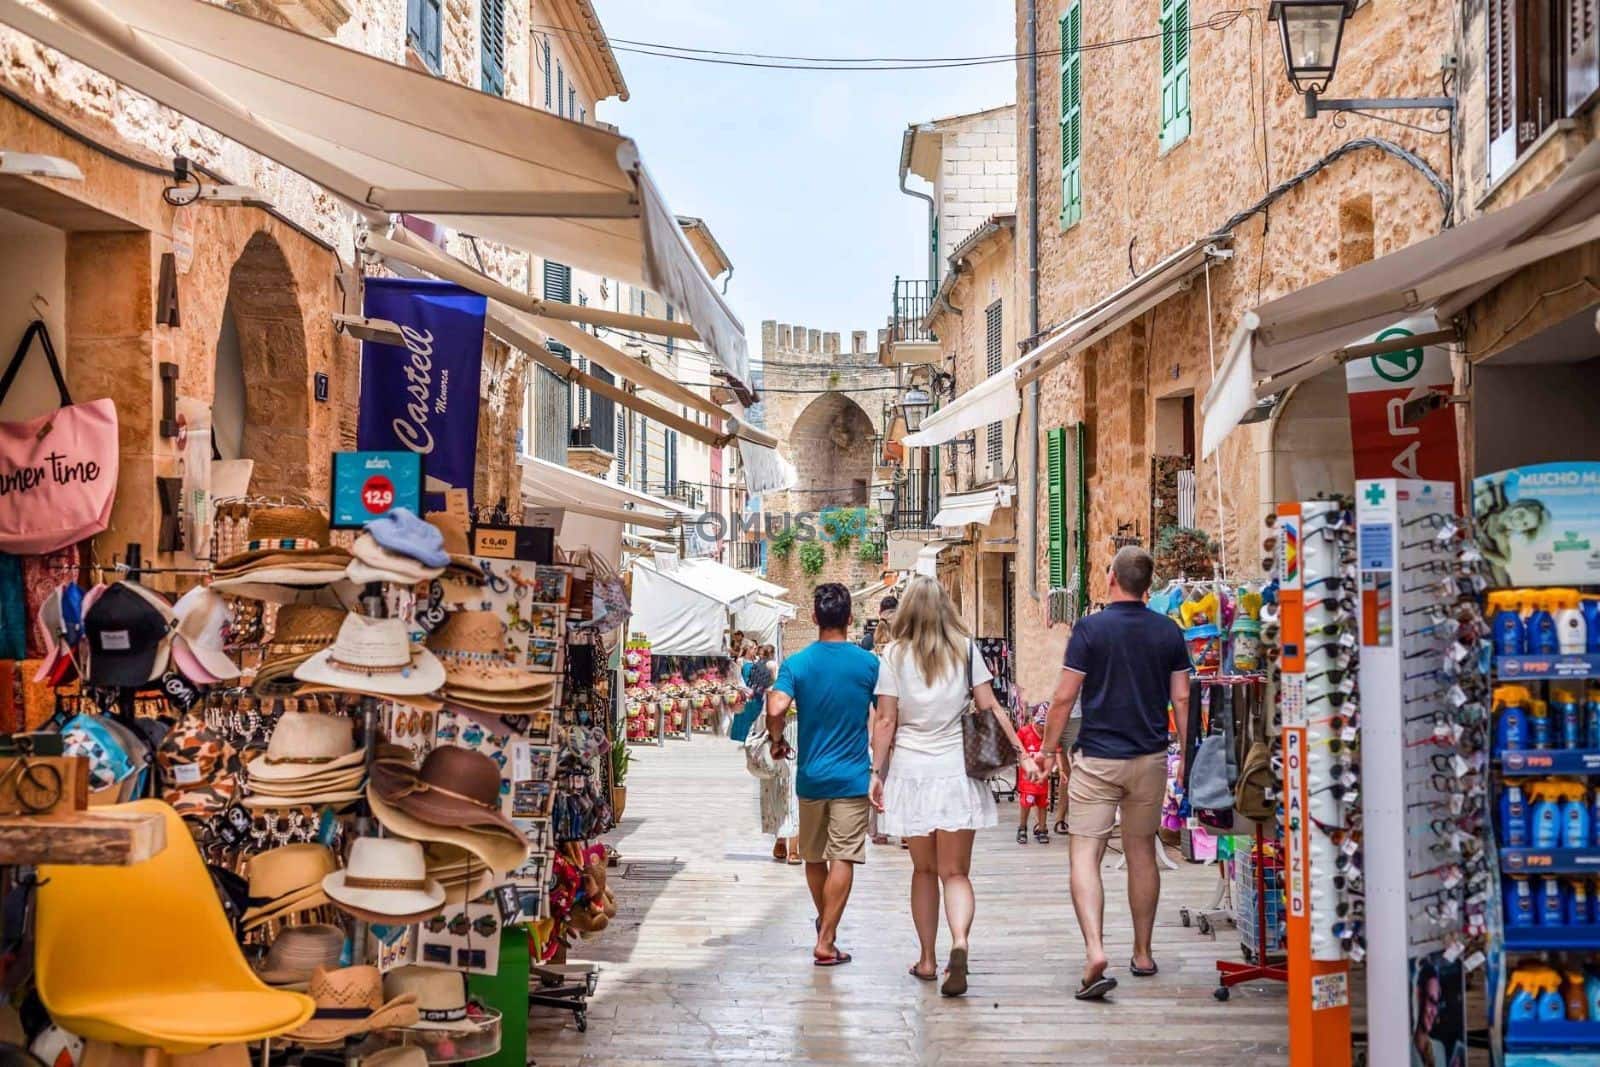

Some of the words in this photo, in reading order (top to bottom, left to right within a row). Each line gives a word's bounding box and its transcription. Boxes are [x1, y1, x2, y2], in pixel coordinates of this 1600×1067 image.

[392, 325, 434, 454] Castell
[43, 451, 101, 486] time
[1288, 734, 1303, 912] POLARIZED
